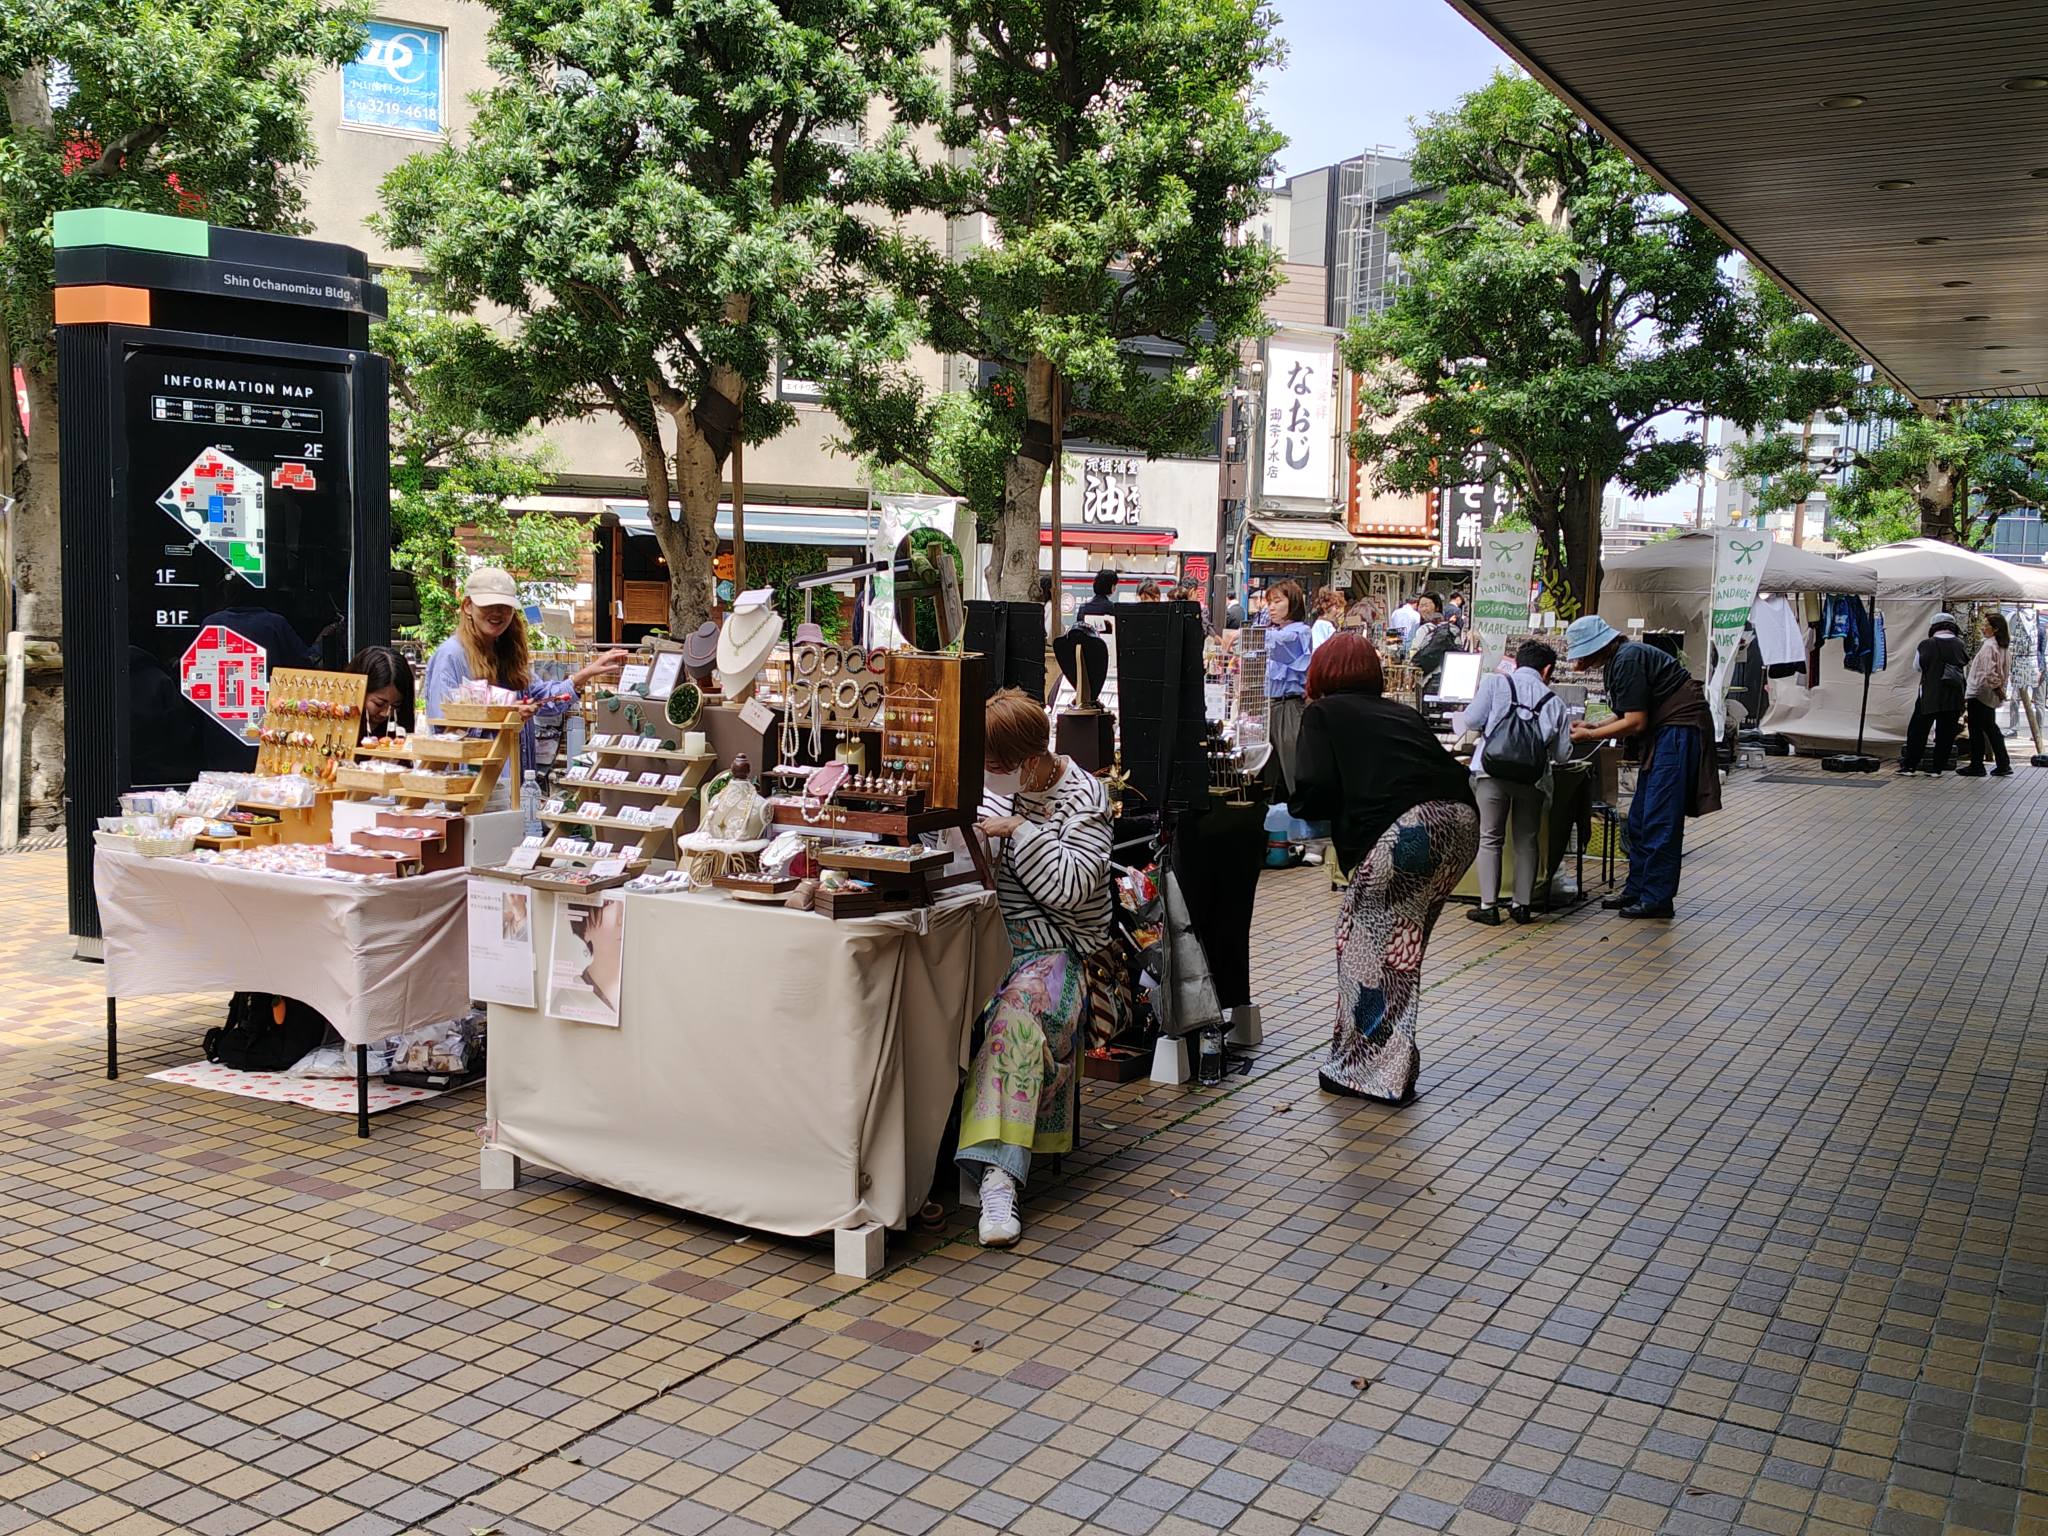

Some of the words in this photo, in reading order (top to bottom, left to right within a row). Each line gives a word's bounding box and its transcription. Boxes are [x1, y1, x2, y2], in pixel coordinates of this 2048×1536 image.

[223, 274, 250, 287] Shin
[252, 277, 323, 296] Ochanomizu
[324, 286, 354, 302] Bldg.
[163, 374, 276, 395] INFORMATION
[281, 384, 315, 399] MAP
[1285, 360, 1315, 471] なおじ
[303, 443, 324, 458] 2F
[1266, 407, 1283, 479] 御茶ノ水店
[1085, 458, 1138, 475] 元祖油堂
[156, 568, 177, 584] 1F
[156, 610, 189, 625] B1F
